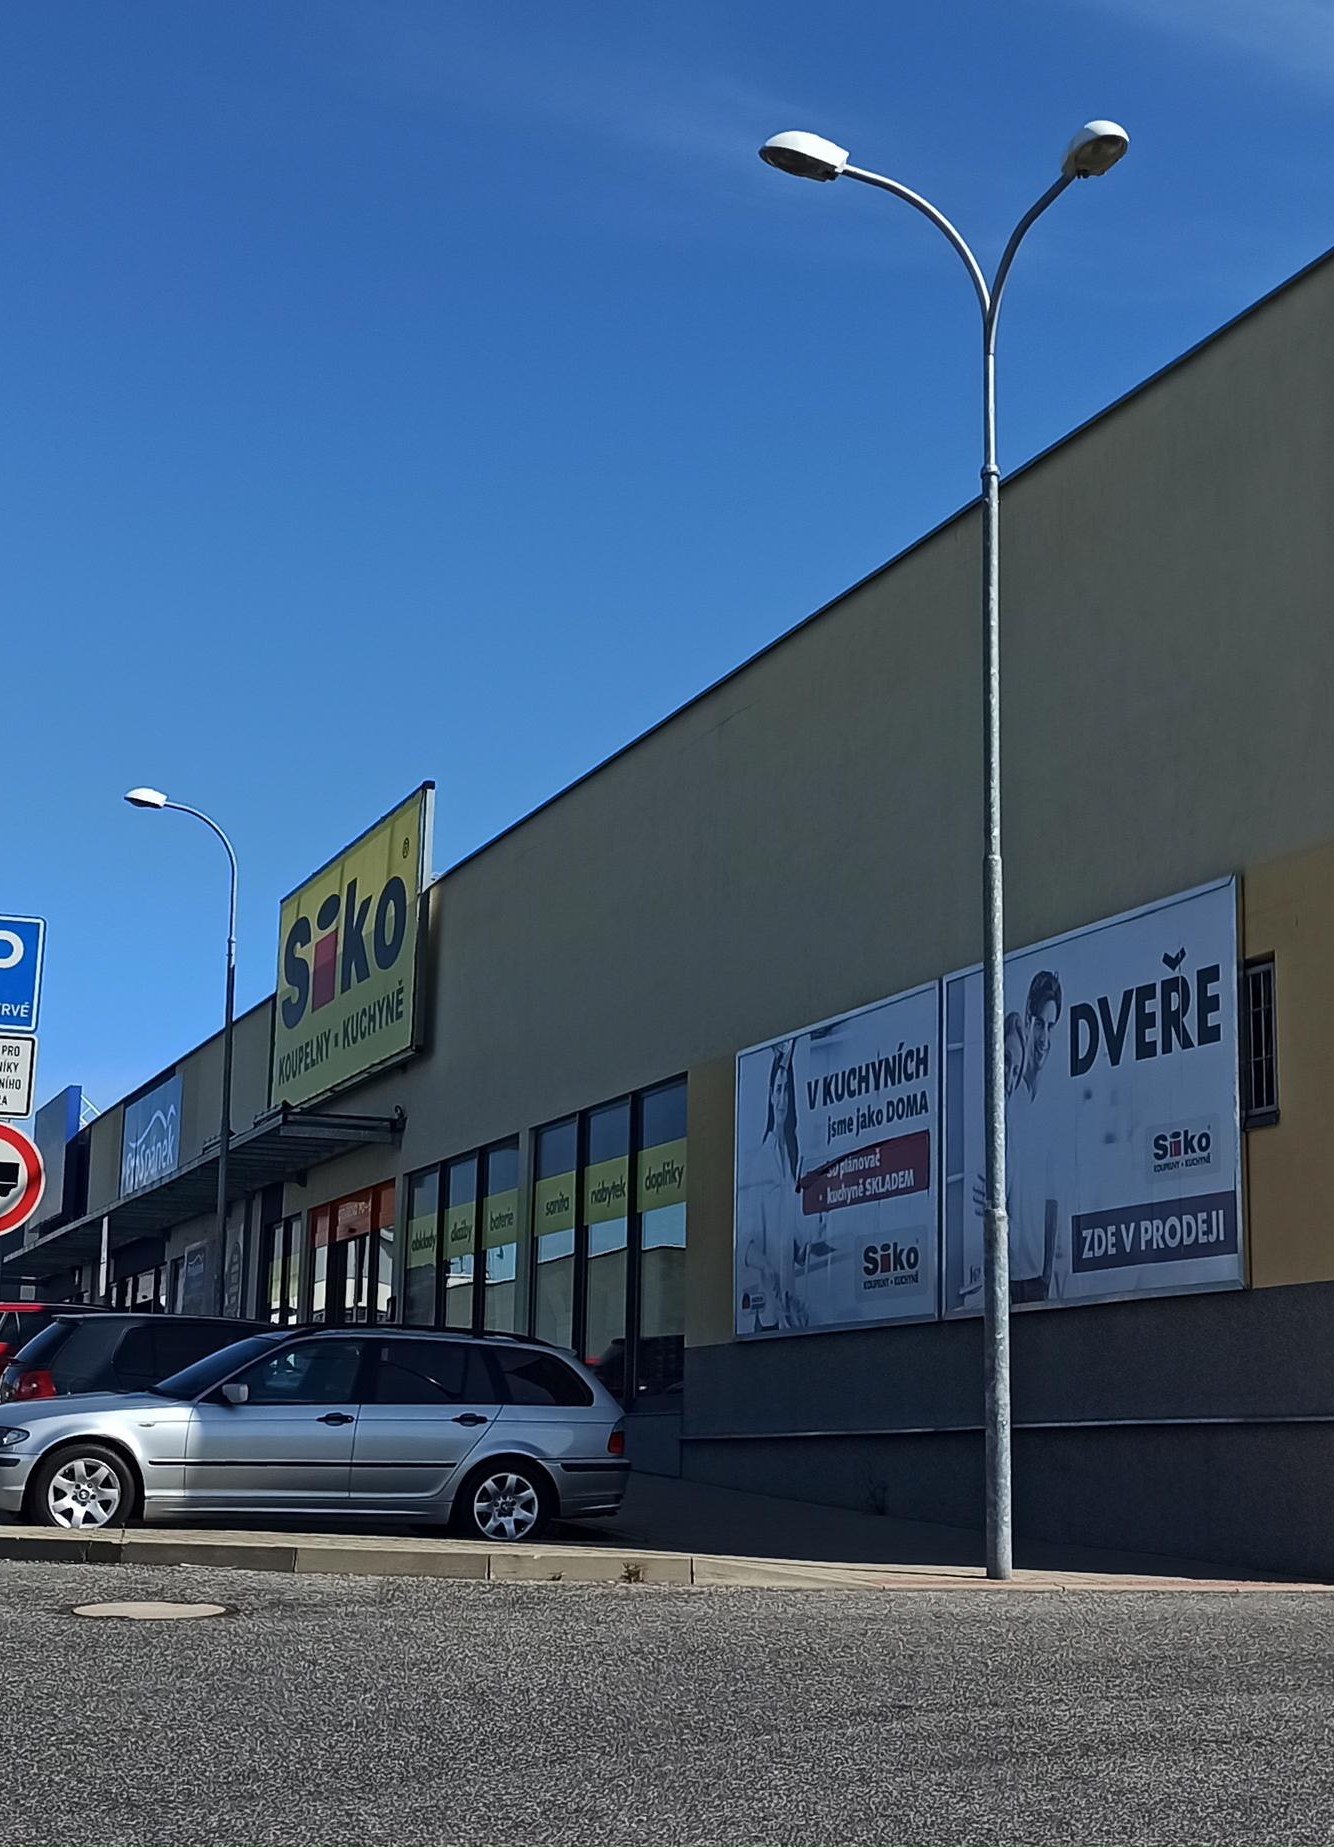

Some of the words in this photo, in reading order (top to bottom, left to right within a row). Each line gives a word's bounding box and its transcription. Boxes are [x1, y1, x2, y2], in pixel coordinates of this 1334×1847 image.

[278, 1028, 331, 1086] KOUPELNY
[342, 980, 405, 1049] KUCHYNĚ
[1069, 947, 1223, 1077] DVEŘE
[1, 1044, 21, 1057] PRO
[807, 1078, 819, 1110] V
[822, 1042, 929, 1106] KUCHYNÍCH
[827, 1116, 854, 1146] jsme
[856, 1104, 884, 1137] jako
[886, 1090, 929, 1124] DOMA
[590, 1175, 627, 1207] nábytek
[644, 1160, 685, 1193] doplňky
[826, 1177, 864, 1205] kuchyně
[865, 1168, 915, 1196] SKLADEM
[1081, 1225, 1117, 1260] ZDE
[1120, 1221, 1136, 1253] V
[1140, 1209, 1225, 1251] PRODEJI
